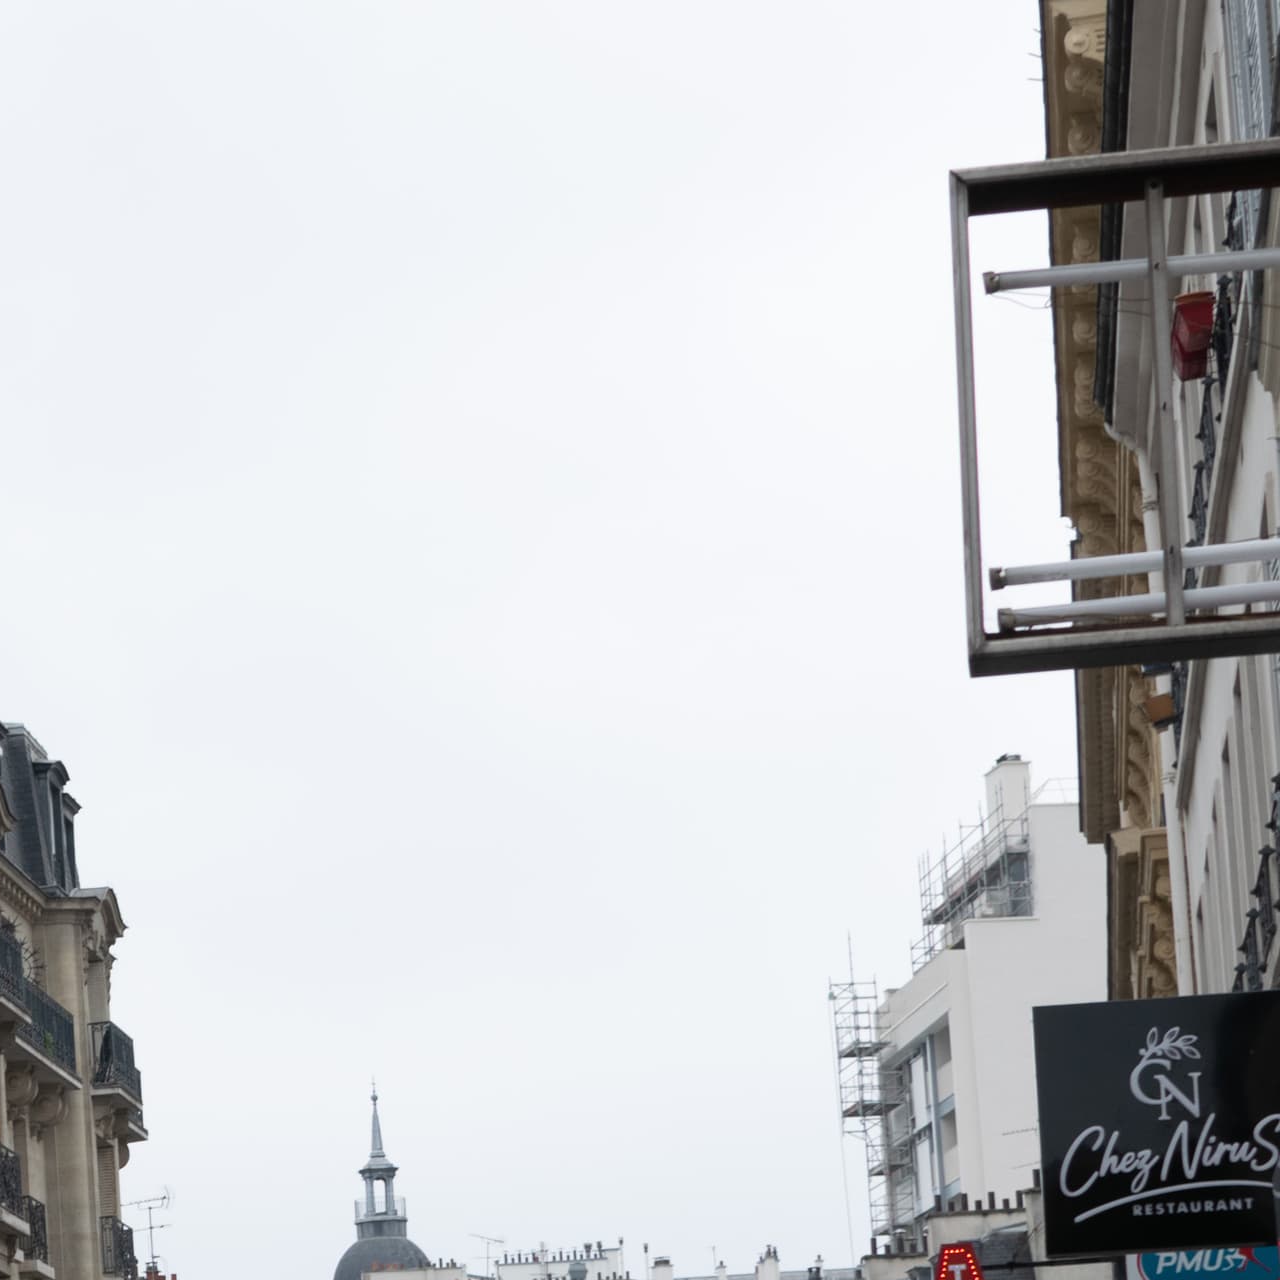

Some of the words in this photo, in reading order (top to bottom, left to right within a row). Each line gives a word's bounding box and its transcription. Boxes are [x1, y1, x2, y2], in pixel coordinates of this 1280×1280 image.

[1059, 1125, 1160, 1198] Chez
[1132, 1198, 1255, 1218] RESTAURANT
[1155, 1248, 1225, 1275] PMU
